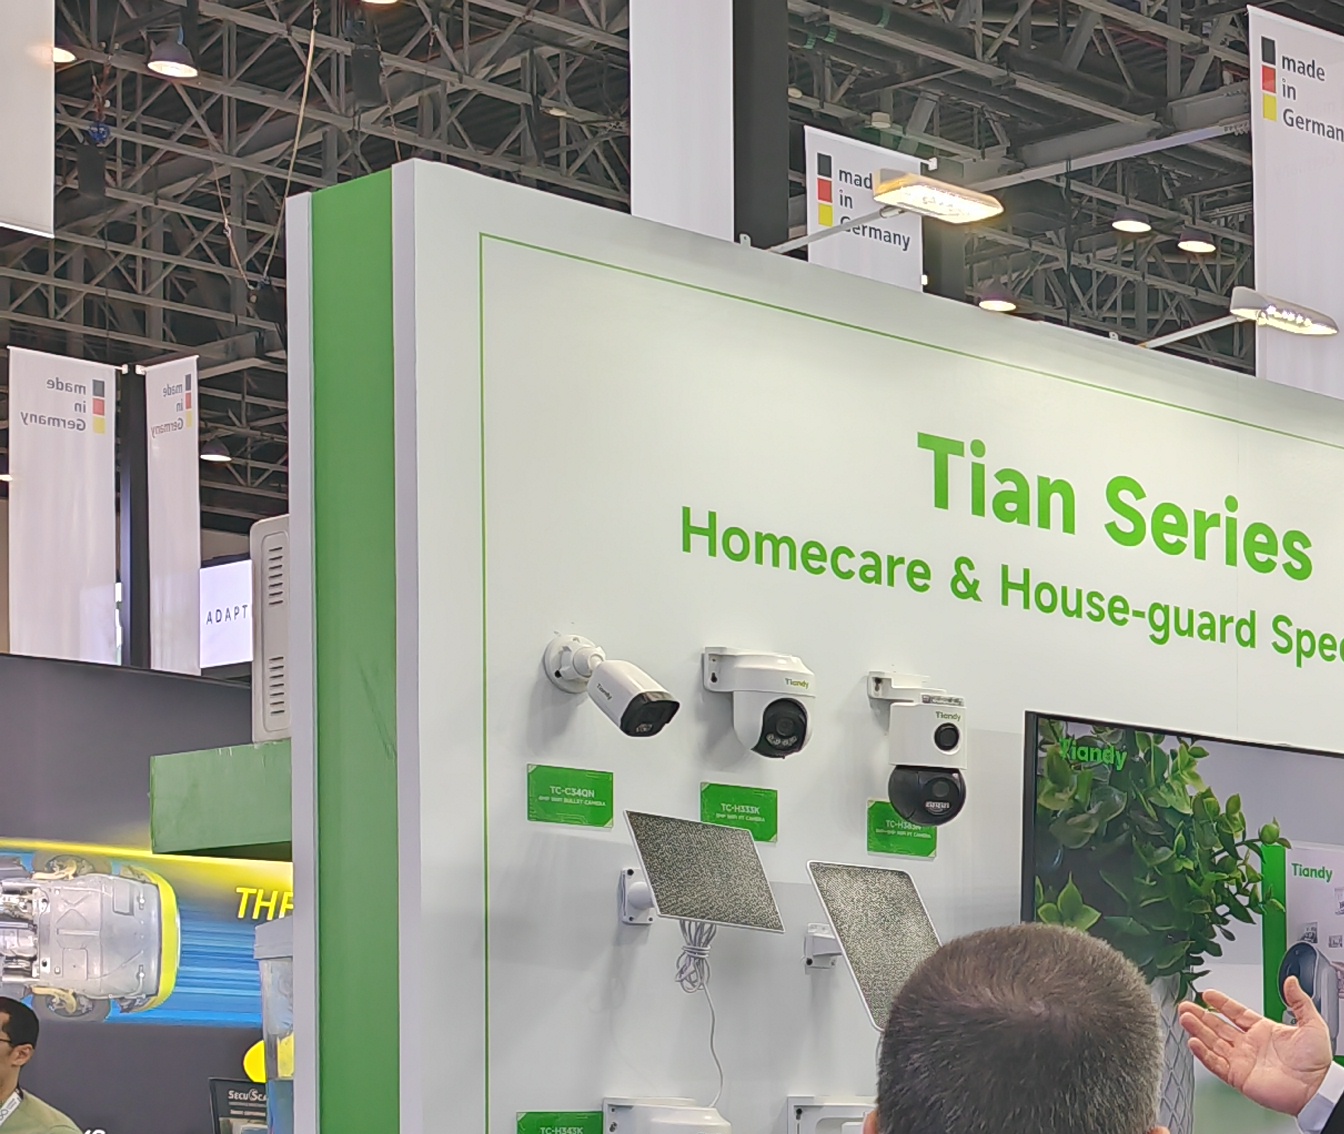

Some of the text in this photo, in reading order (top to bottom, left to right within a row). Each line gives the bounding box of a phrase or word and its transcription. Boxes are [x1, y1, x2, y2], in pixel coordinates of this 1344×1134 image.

[1281, 51, 1325, 82] made
[1282, 77, 1296, 99] in
[838, 164, 873, 190] mad
[838, 189, 853, 209] in
[917, 431, 1313, 582] Tian Series
[681, 506, 932, 593] Homecare
[950, 556, 982, 603] &
[1001, 564, 1256, 647] House-guard
[1059, 737, 1128, 771] Tiandy
[1291, 863, 1333, 883] Tiandy
